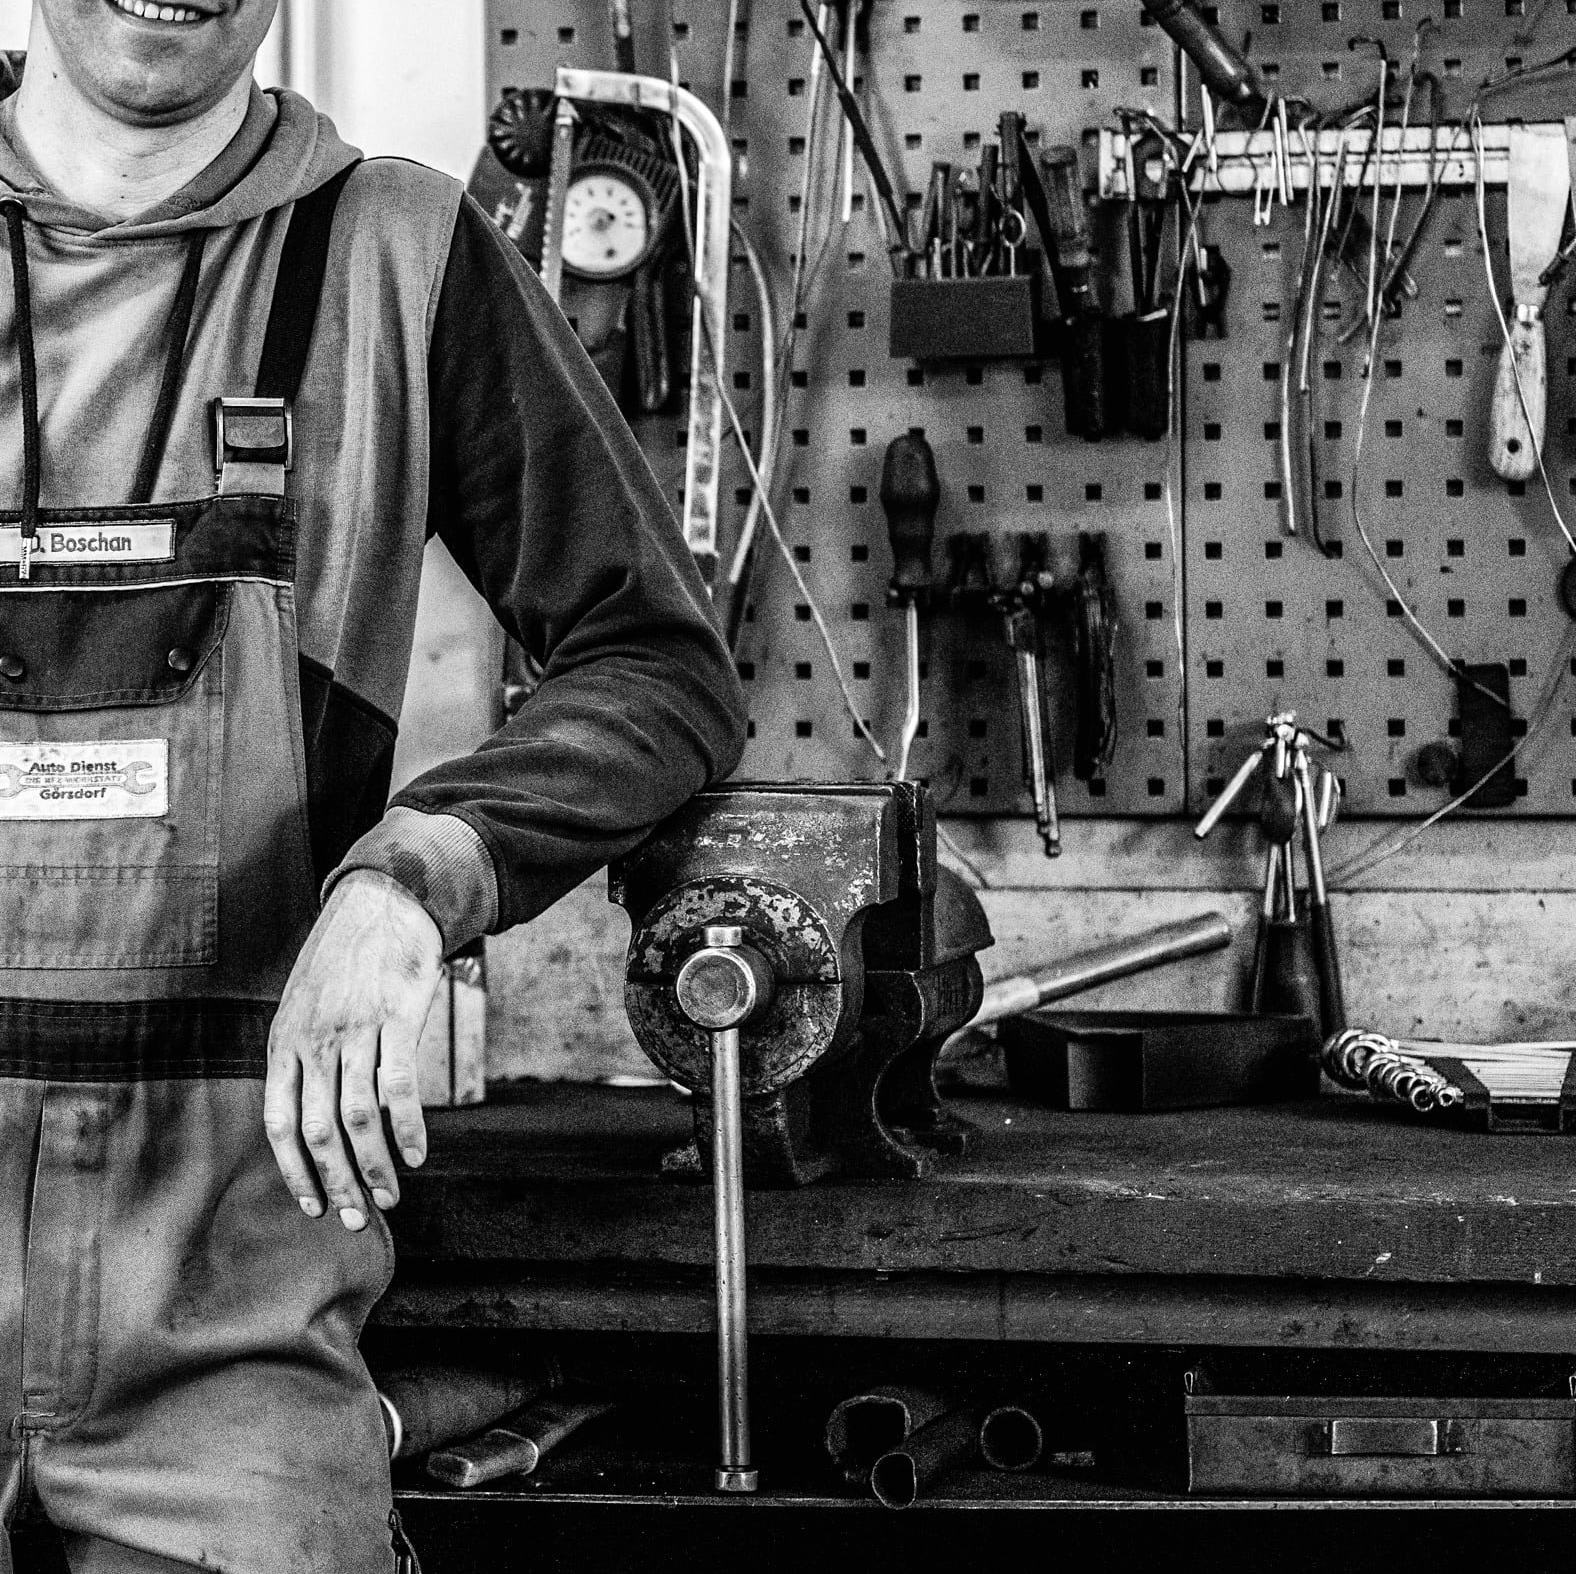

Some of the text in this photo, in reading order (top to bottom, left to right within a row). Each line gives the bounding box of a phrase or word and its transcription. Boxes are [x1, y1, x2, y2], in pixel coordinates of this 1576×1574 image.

[50, 532, 132, 553] Boschan
[28, 761, 118, 775] Auto Dienst
[39, 786, 107, 800] Görsdorf
